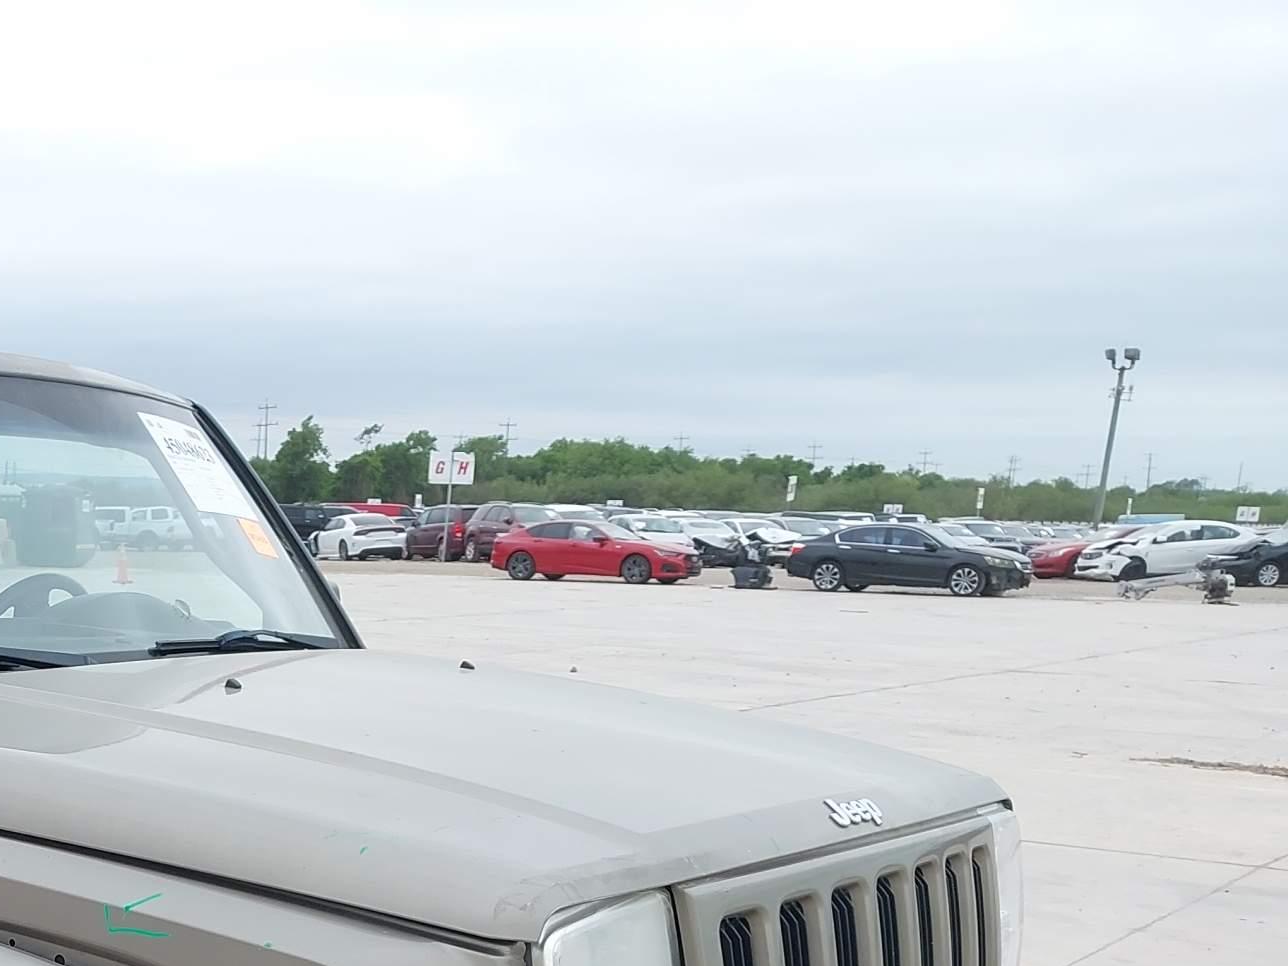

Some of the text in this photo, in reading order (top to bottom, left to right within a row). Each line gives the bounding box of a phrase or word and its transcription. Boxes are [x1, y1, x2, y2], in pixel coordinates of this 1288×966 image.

[435, 460, 470, 476] G H
[822, 798, 883, 828] Jeep
